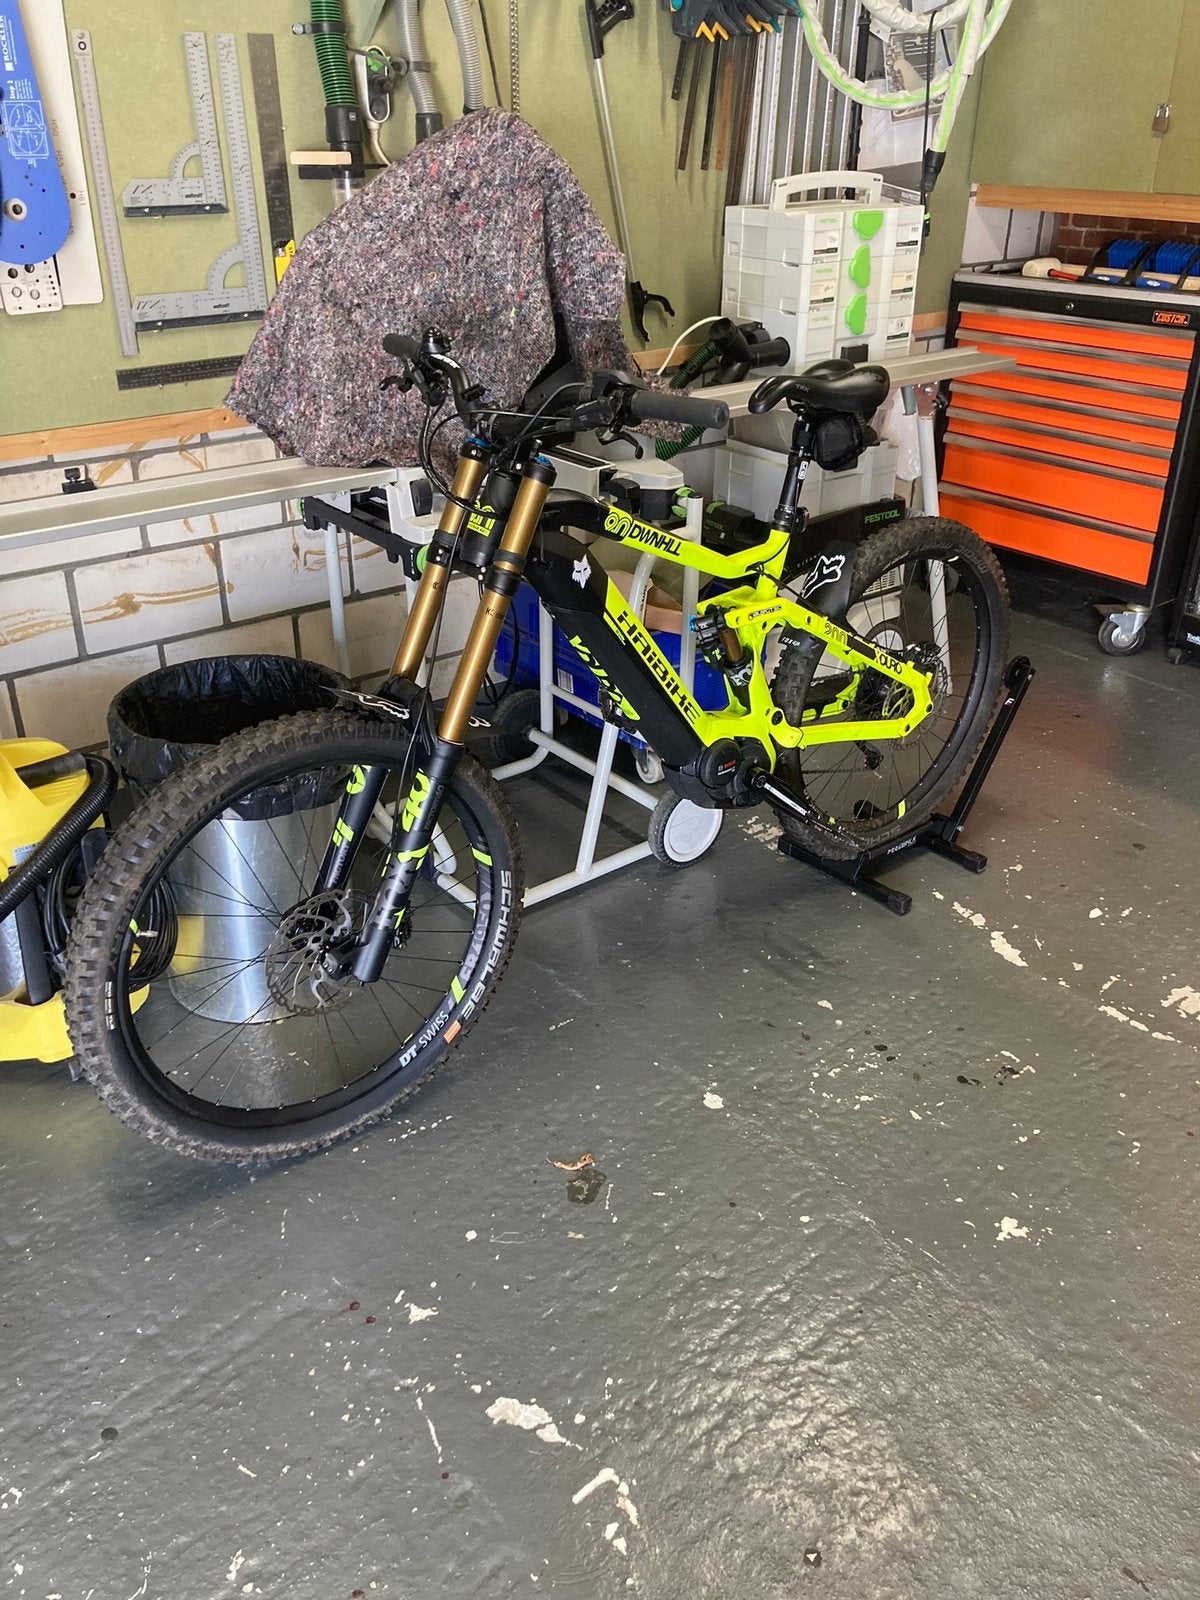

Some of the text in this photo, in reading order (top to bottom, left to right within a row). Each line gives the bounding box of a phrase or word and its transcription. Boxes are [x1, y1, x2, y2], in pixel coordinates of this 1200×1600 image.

[864, 509, 901, 524] FESTOOL
[461, 869, 513, 1021] SCHWALBE
[398, 1043, 418, 1068] DT
[418, 1010, 450, 1049] SWISS
